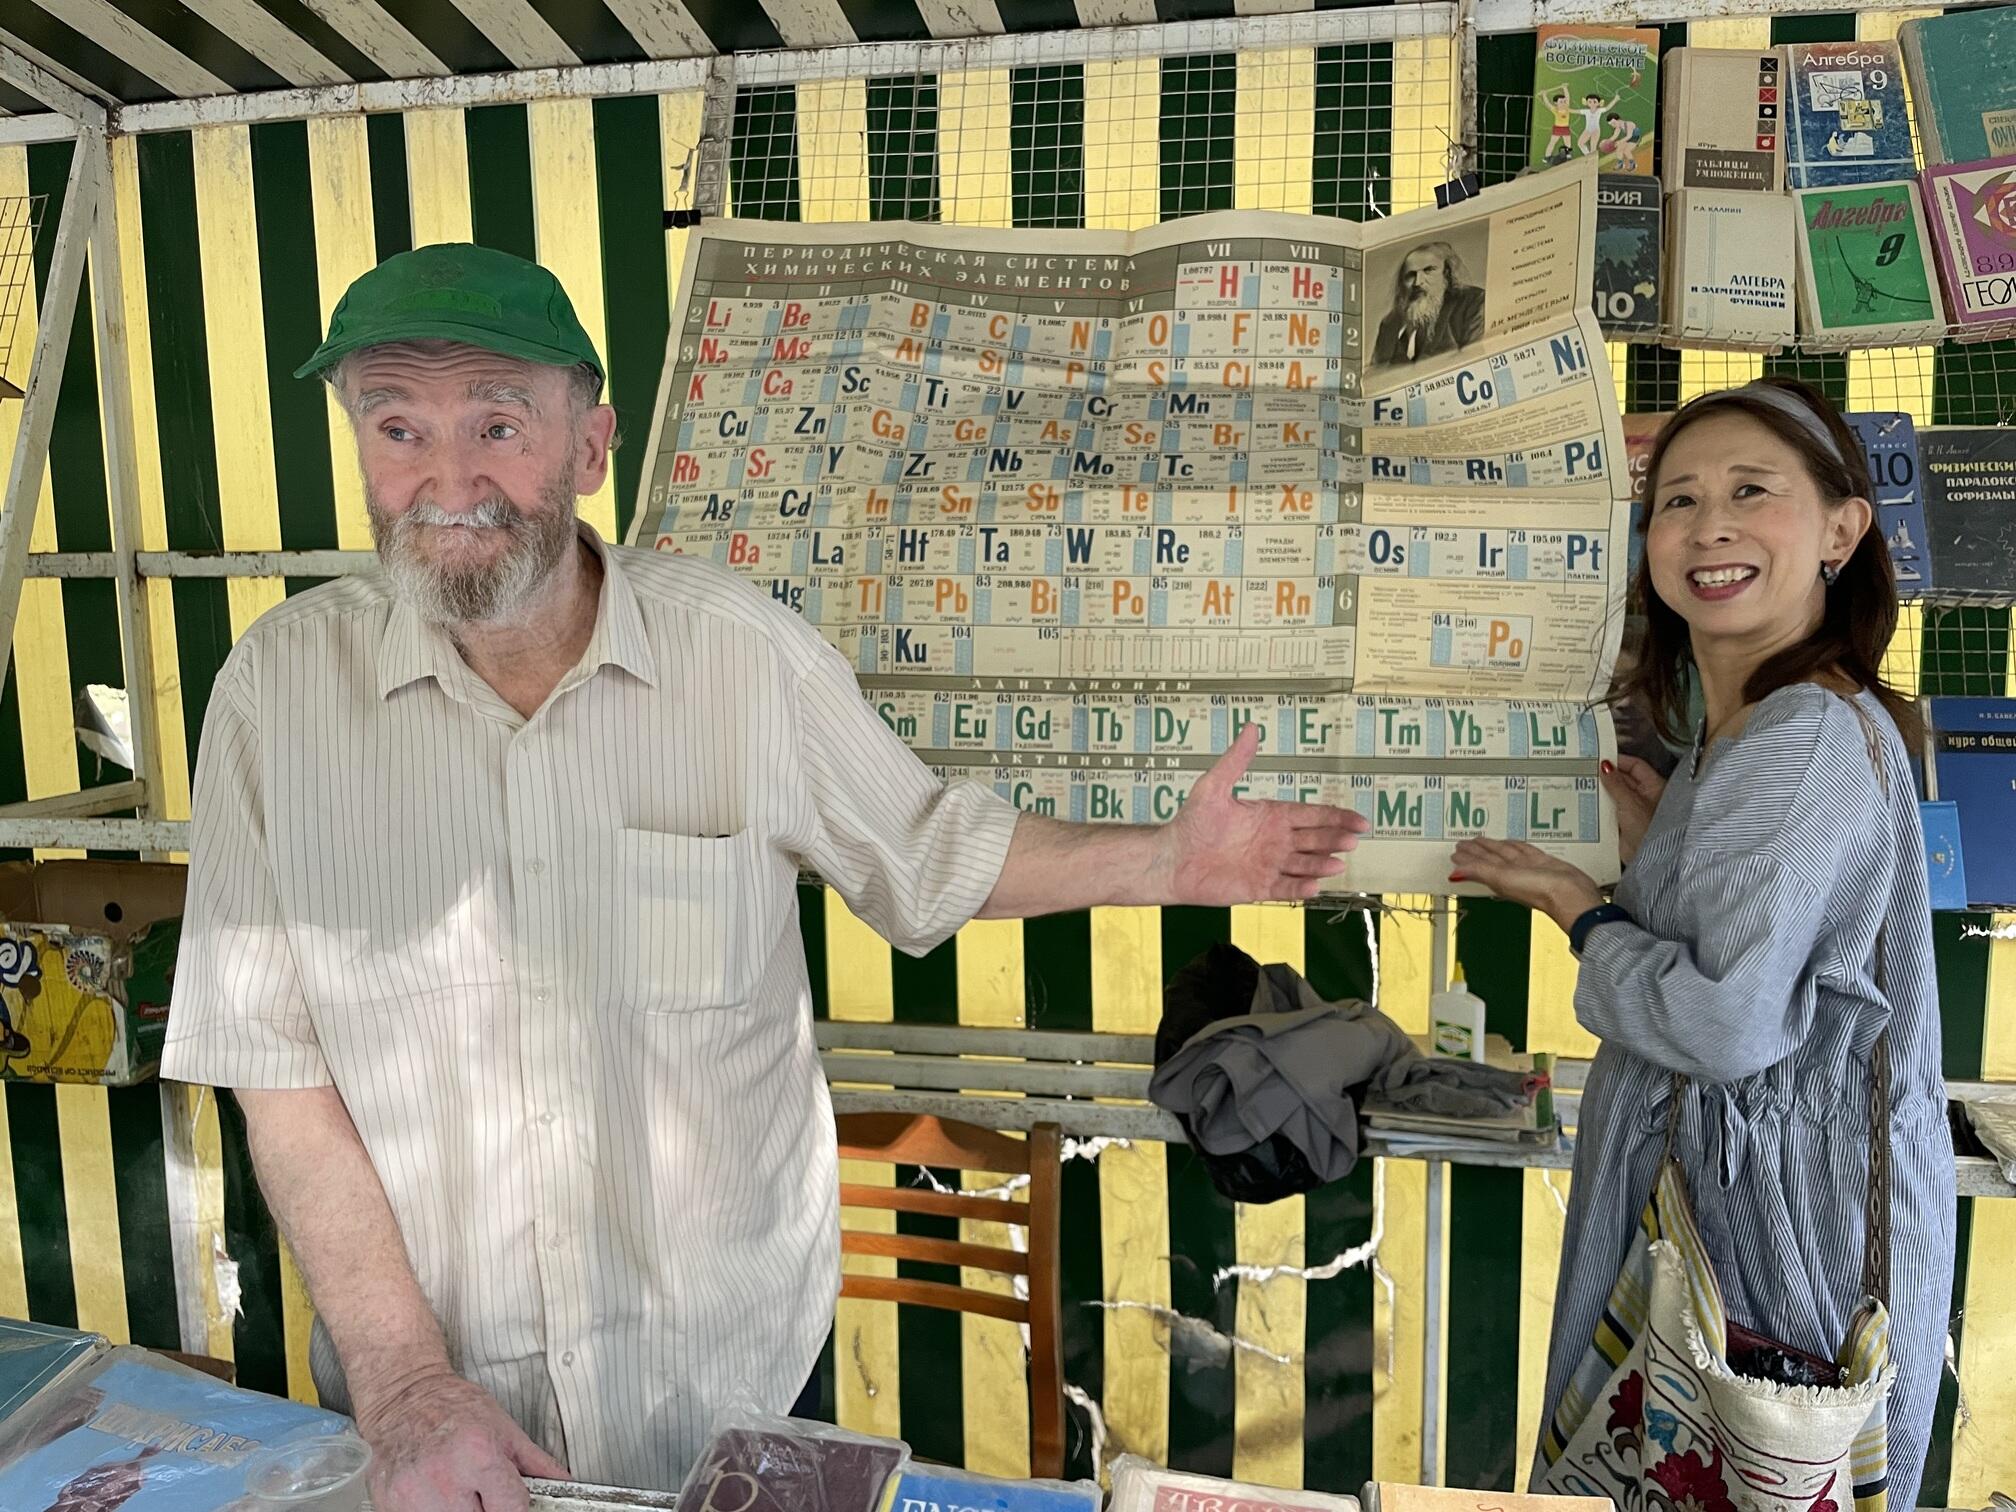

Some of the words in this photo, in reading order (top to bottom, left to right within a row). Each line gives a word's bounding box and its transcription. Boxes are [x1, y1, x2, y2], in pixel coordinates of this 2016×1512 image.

[1545, 40, 1648, 54] ФИЗИЧЕСКОЕ
[1546, 53, 1645, 69] ВОСПИТАНИЕ
[1803, 50, 1884, 67] Алгебра
[1870, 70, 1887, 90] 9
[1696, 160, 1748, 169] ТАБЛИЦЫ
[743, 244, 986, 267] ПЕРИОДИЧЕСКАЯ
[1006, 257, 1137, 273] СИСТЕМА
[1875, 233, 1905, 266] 9
[744, 260, 933, 278] ХИМИЧЕСКИХ
[955, 271, 1131, 291] ЭЛЕМЕНТОВ
[890, 279, 909, 294] III
[970, 294, 989, 306] IV
[1054, 301, 1066, 314] V
[1128, 298, 1144, 313] VI
[1207, 243, 1231, 257] VII
[1290, 244, 1319, 260] VIII
[1219, 265, 1238, 298] H
[1292, 267, 1324, 299] He
[1730, 275, 1785, 289] АЛГЕБРА
[1596, 291, 1635, 319] 10
[1702, 286, 1784, 299] ЭЛЕМЕНТАРНЫЕ
[1730, 297, 1785, 309] ФУНКЦИИ
[706, 301, 732, 329] Li
[782, 303, 811, 329] Be
[909, 303, 930, 329] B
[988, 315, 1009, 341] C
[1329, 313, 1340, 324] 10
[1070, 320, 1090, 351] N
[1232, 313, 1251, 346] F
[1289, 313, 1320, 346] Ne
[698, 338, 728, 364] Na
[774, 337, 812, 361] Mg
[895, 337, 922, 363] Al
[1491, 355, 1508, 370] 28
[1550, 335, 1586, 376] Ni
[763, 370, 794, 396] Ca
[842, 366, 871, 394] Sc
[1066, 361, 1085, 385] P
[1147, 361, 1165, 388] S
[1286, 361, 1318, 390] Ar
[688, 374, 708, 402] K
[924, 378, 949, 409] Ti
[1005, 391, 1025, 410] V
[1456, 371, 1493, 406] Co
[1087, 396, 1119, 417] Cr
[1169, 393, 1210, 414] Mn
[1373, 398, 1404, 421] Fe
[719, 410, 748, 438] Cu
[794, 407, 826, 435] Zn
[871, 410, 905, 440] Ga
[914, 415, 929, 425] 32
[954, 419, 986, 443] Ge
[1040, 423, 1071, 441] As
[1124, 424, 1156, 444] Se
[1283, 423, 1316, 443] Kr
[1214, 424, 1245, 445] Br
[672, 454, 700, 484] Rb
[747, 449, 776, 478] Sr
[827, 446, 845, 474] Y
[905, 453, 936, 477] Zr
[989, 449, 1023, 473] Nb
[1074, 452, 1114, 476] Mo
[1164, 454, 1194, 477] Tc
[1371, 457, 1406, 477] Ru
[1466, 459, 1502, 480] Rh
[1564, 440, 1601, 475] Pd
[1870, 452, 1913, 487] 10
[1929, 461, 2016, 473] ФИЗИЧЕСКИ
[701, 494, 733, 521] Ag
[779, 489, 812, 517] Cd
[865, 488, 888, 515] In
[940, 485, 972, 514] Sn
[1025, 483, 1060, 512] Sb
[1119, 485, 1148, 512] Te
[1279, 485, 1313, 512] Xe
[1947, 491, 2015, 501] СОФИЗМЫ
[900, 529, 930, 563] Hf
[980, 528, 1013, 561] Ta
[1066, 528, 1095, 564] W
[1137, 527, 1151, 538] 74
[1157, 529, 1190, 564] Re
[1510, 531, 1526, 543] 78
[728, 532, 760, 565] Ba
[812, 532, 844, 565] La
[1369, 530, 1405, 565] Os
[1479, 533, 1503, 567] Ir
[1567, 534, 1602, 571] Pt
[889, 576, 904, 586] 82
[1064, 577, 1079, 589] 84
[935, 579, 968, 613] Pb
[1030, 580, 1057, 615] Bi
[1112, 580, 1144, 616] Po
[1202, 580, 1235, 616] At
[1276, 580, 1311, 616] Rn
[951, 627, 971, 639] 104
[1037, 628, 1059, 640] 105
[1434, 614, 1450, 626] 84
[895, 628, 927, 663] Ku
[1488, 620, 1523, 658] Po
[972, 679, 1191, 691] ЛАНТАНОИДЫ
[954, 704, 987, 738] Eu
[1015, 706, 1050, 740] Gd
[1091, 707, 1123, 742] Tb
[1154, 708, 1190, 747] Dy
[1299, 708, 1332, 745] Er
[1379, 709, 1420, 746] Tm
[1449, 710, 1482, 746] Yb
[1531, 712, 1566, 747] Lu
[1948, 736, 1976, 748] курс
[990, 752, 1180, 768] АКТИНОИДЫ
[1575, 777, 1597, 791] 103
[1091, 784, 1124, 818] Bk
[1377, 791, 1422, 827] Md
[1530, 792, 1565, 828] Lr
